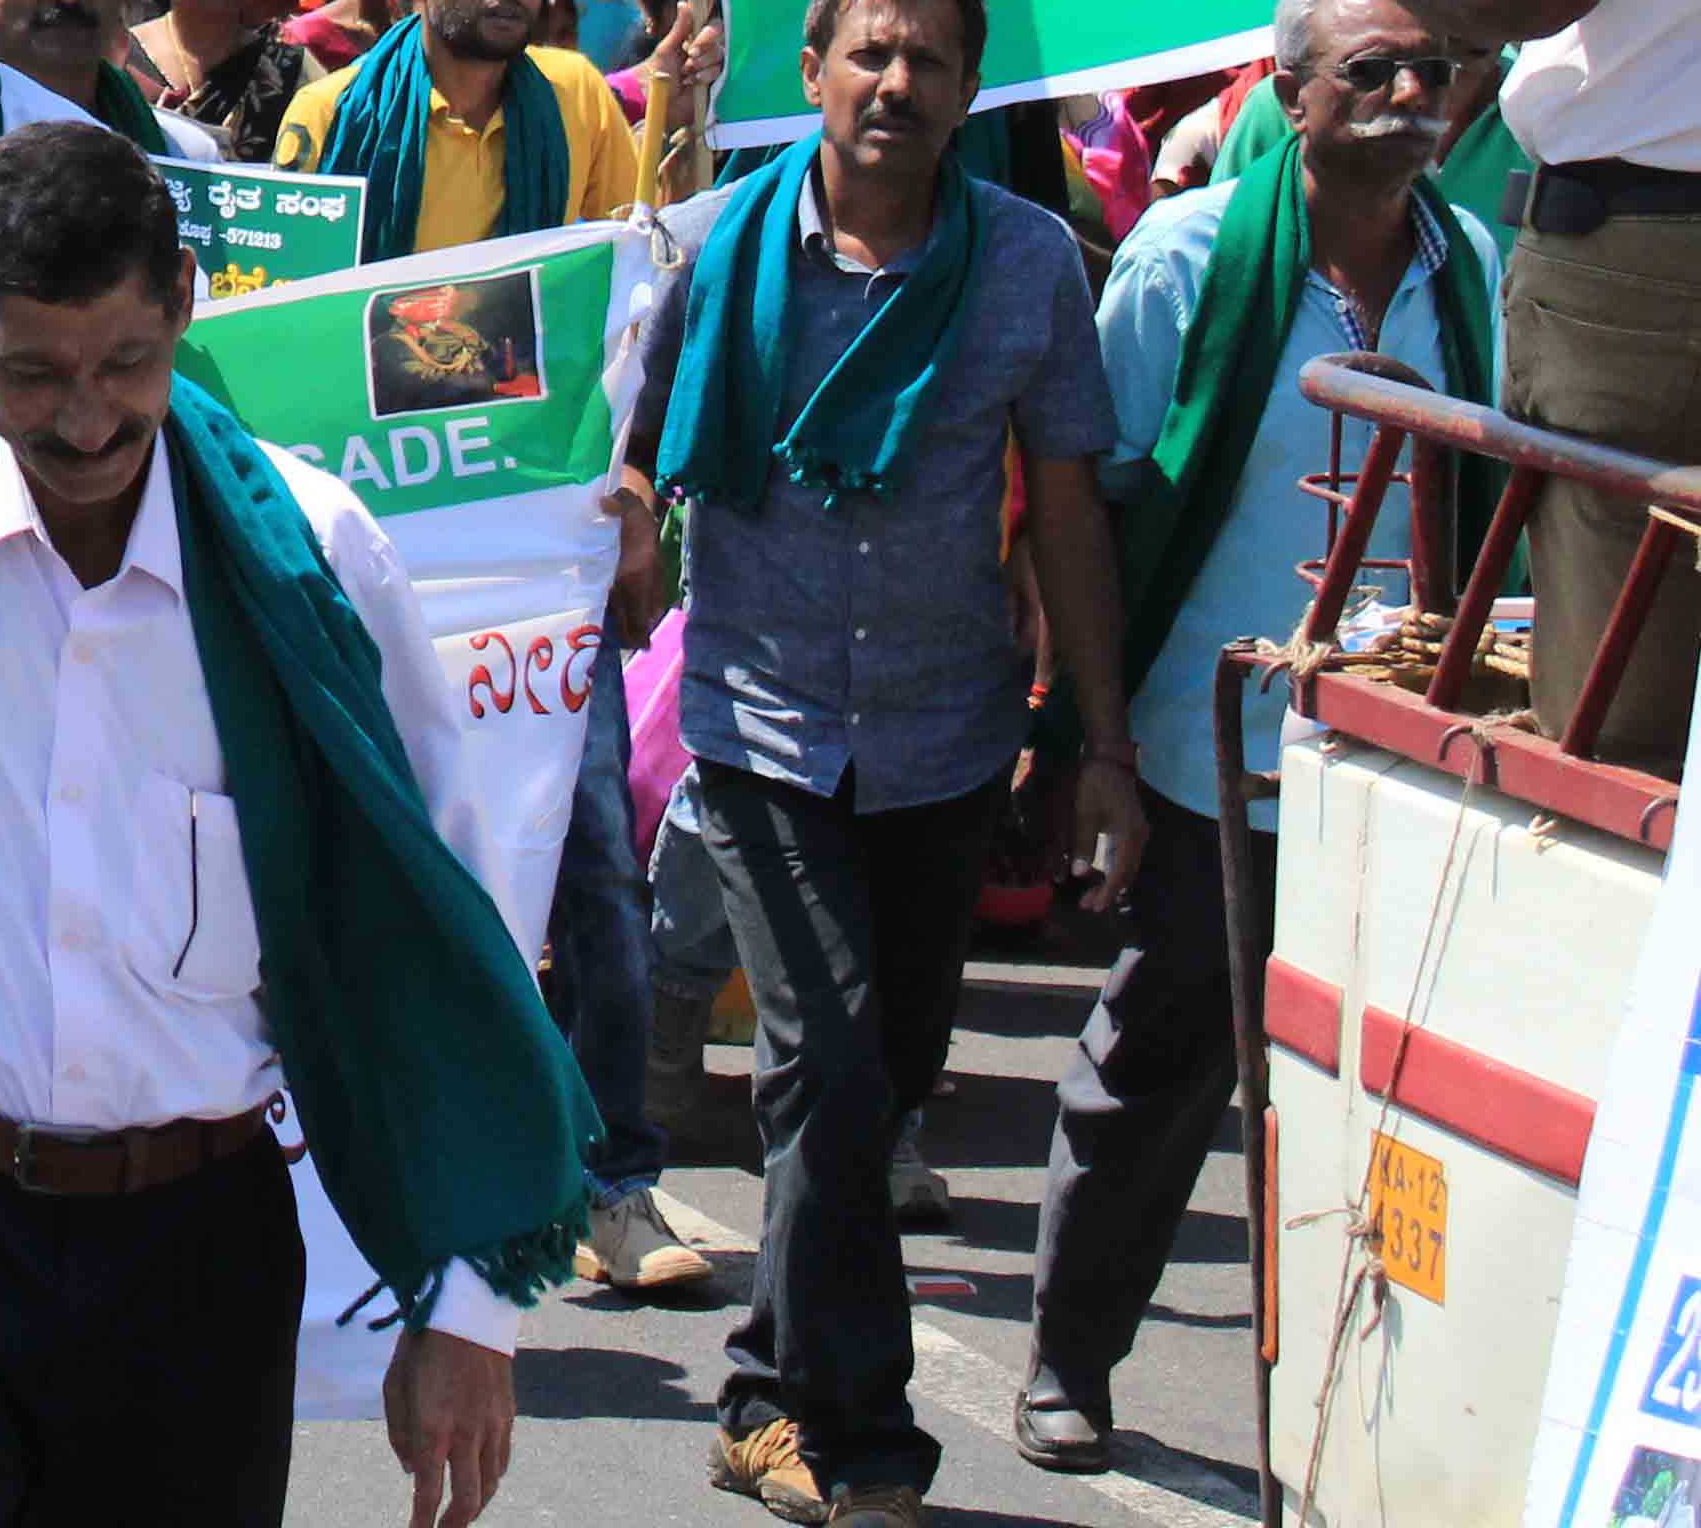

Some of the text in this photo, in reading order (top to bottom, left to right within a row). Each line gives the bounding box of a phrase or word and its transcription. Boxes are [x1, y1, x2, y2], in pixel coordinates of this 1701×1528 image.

[207, 180, 261, 219] ರೈತ
[275, 190, 346, 223] ಸಂಘ
[218, 226, 283, 250] -571213
